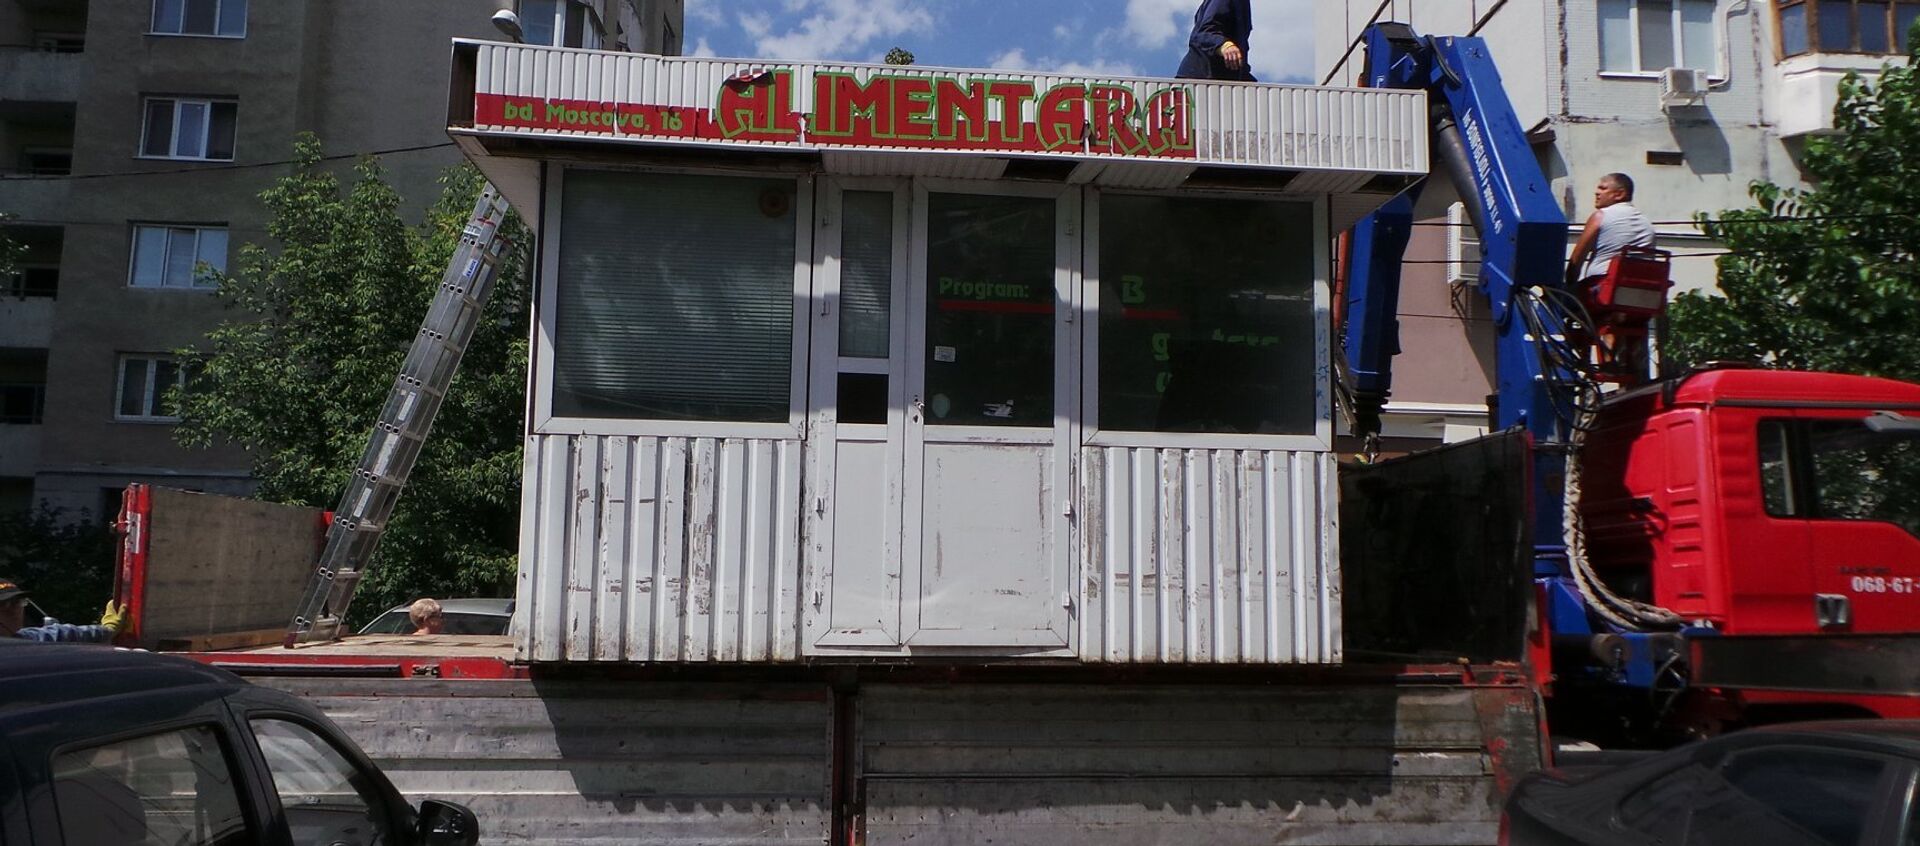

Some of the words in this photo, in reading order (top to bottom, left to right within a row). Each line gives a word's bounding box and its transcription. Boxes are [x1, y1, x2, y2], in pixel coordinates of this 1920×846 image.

[504, 101, 538, 122] bd.
[545, 104, 650, 131] Moscova,
[659, 111, 683, 131] 16
[715, 67, 1194, 156] ALIMENTARA
[938, 276, 1030, 300] Program:
